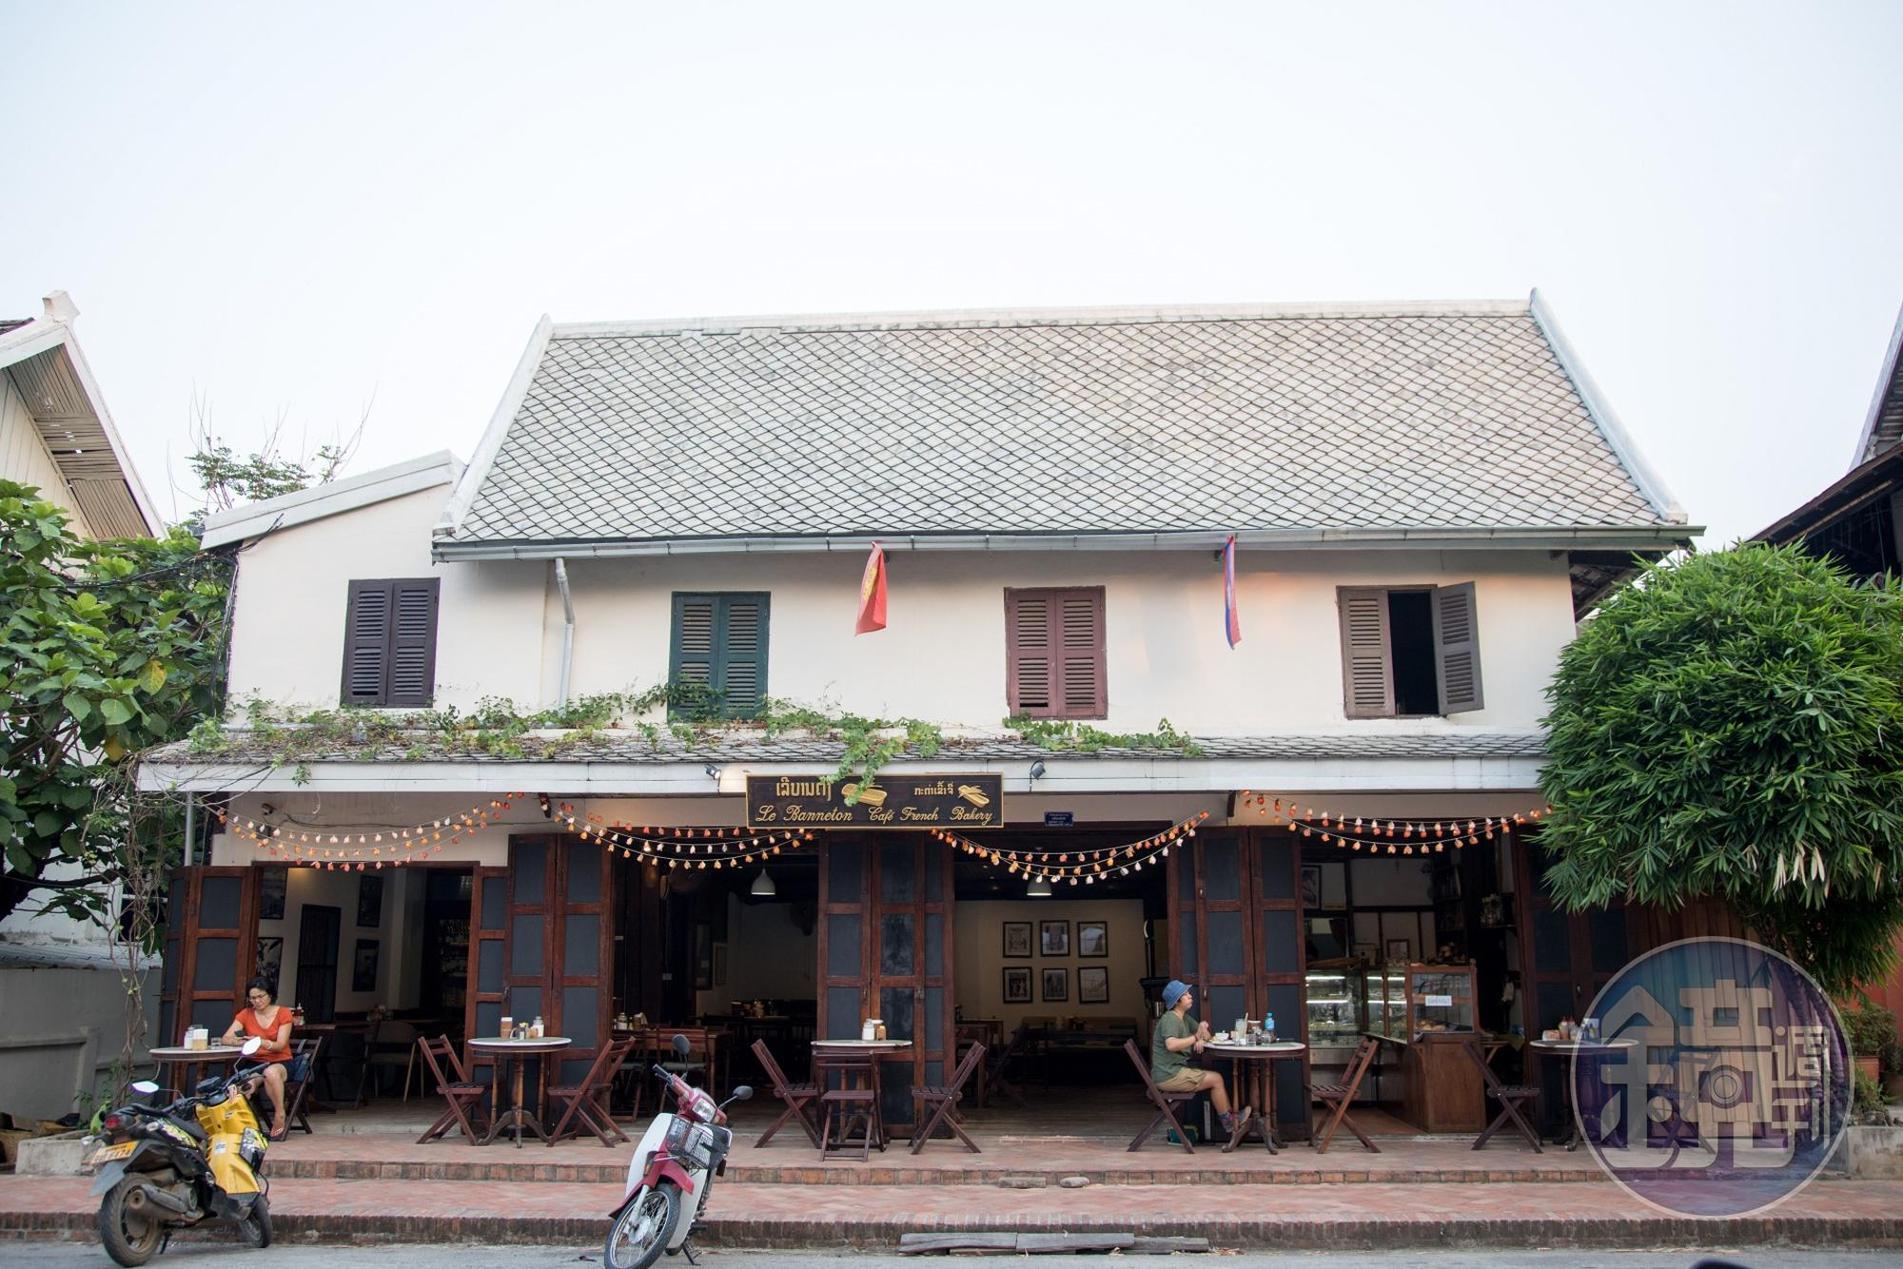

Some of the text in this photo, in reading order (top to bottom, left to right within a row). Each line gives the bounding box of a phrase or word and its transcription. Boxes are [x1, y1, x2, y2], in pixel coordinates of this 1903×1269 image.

[776, 776, 832, 802] ເລີບານຕງ
[755, 804, 993, 826] Le Banneton Café French Bakery
